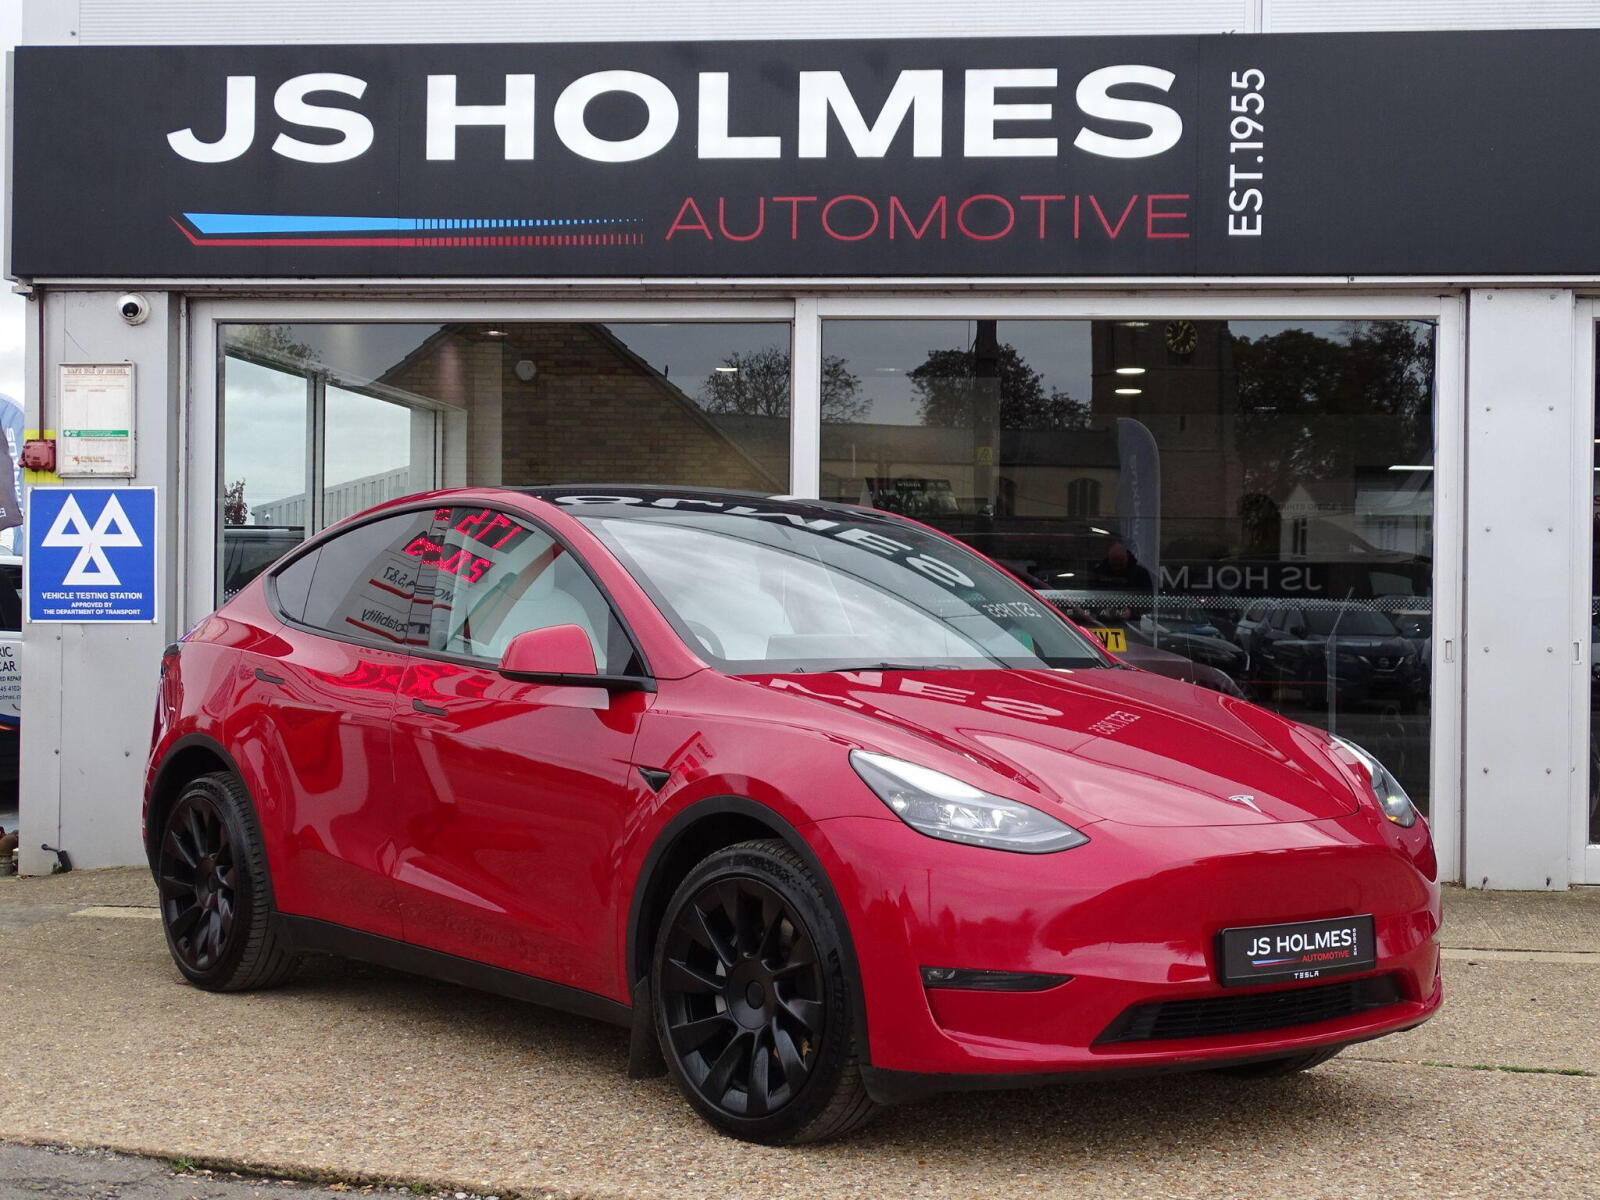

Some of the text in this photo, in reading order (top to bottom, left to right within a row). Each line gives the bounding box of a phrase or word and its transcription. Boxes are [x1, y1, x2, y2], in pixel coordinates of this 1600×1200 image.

[166, 64, 1184, 164] JS HOLMES
[1228, 68, 1266, 237] EST.1955
[665, 193, 1191, 242] AUTOMOTIVE
[42, 592, 143, 600] VEHICLE TESTING STATION
[1247, 937, 1271, 957] JS
[1276, 928, 1352, 953] HOLMES
[1301, 949, 1351, 963] AUTOMOTIVE
[1294, 970, 1320, 979] TESLA
